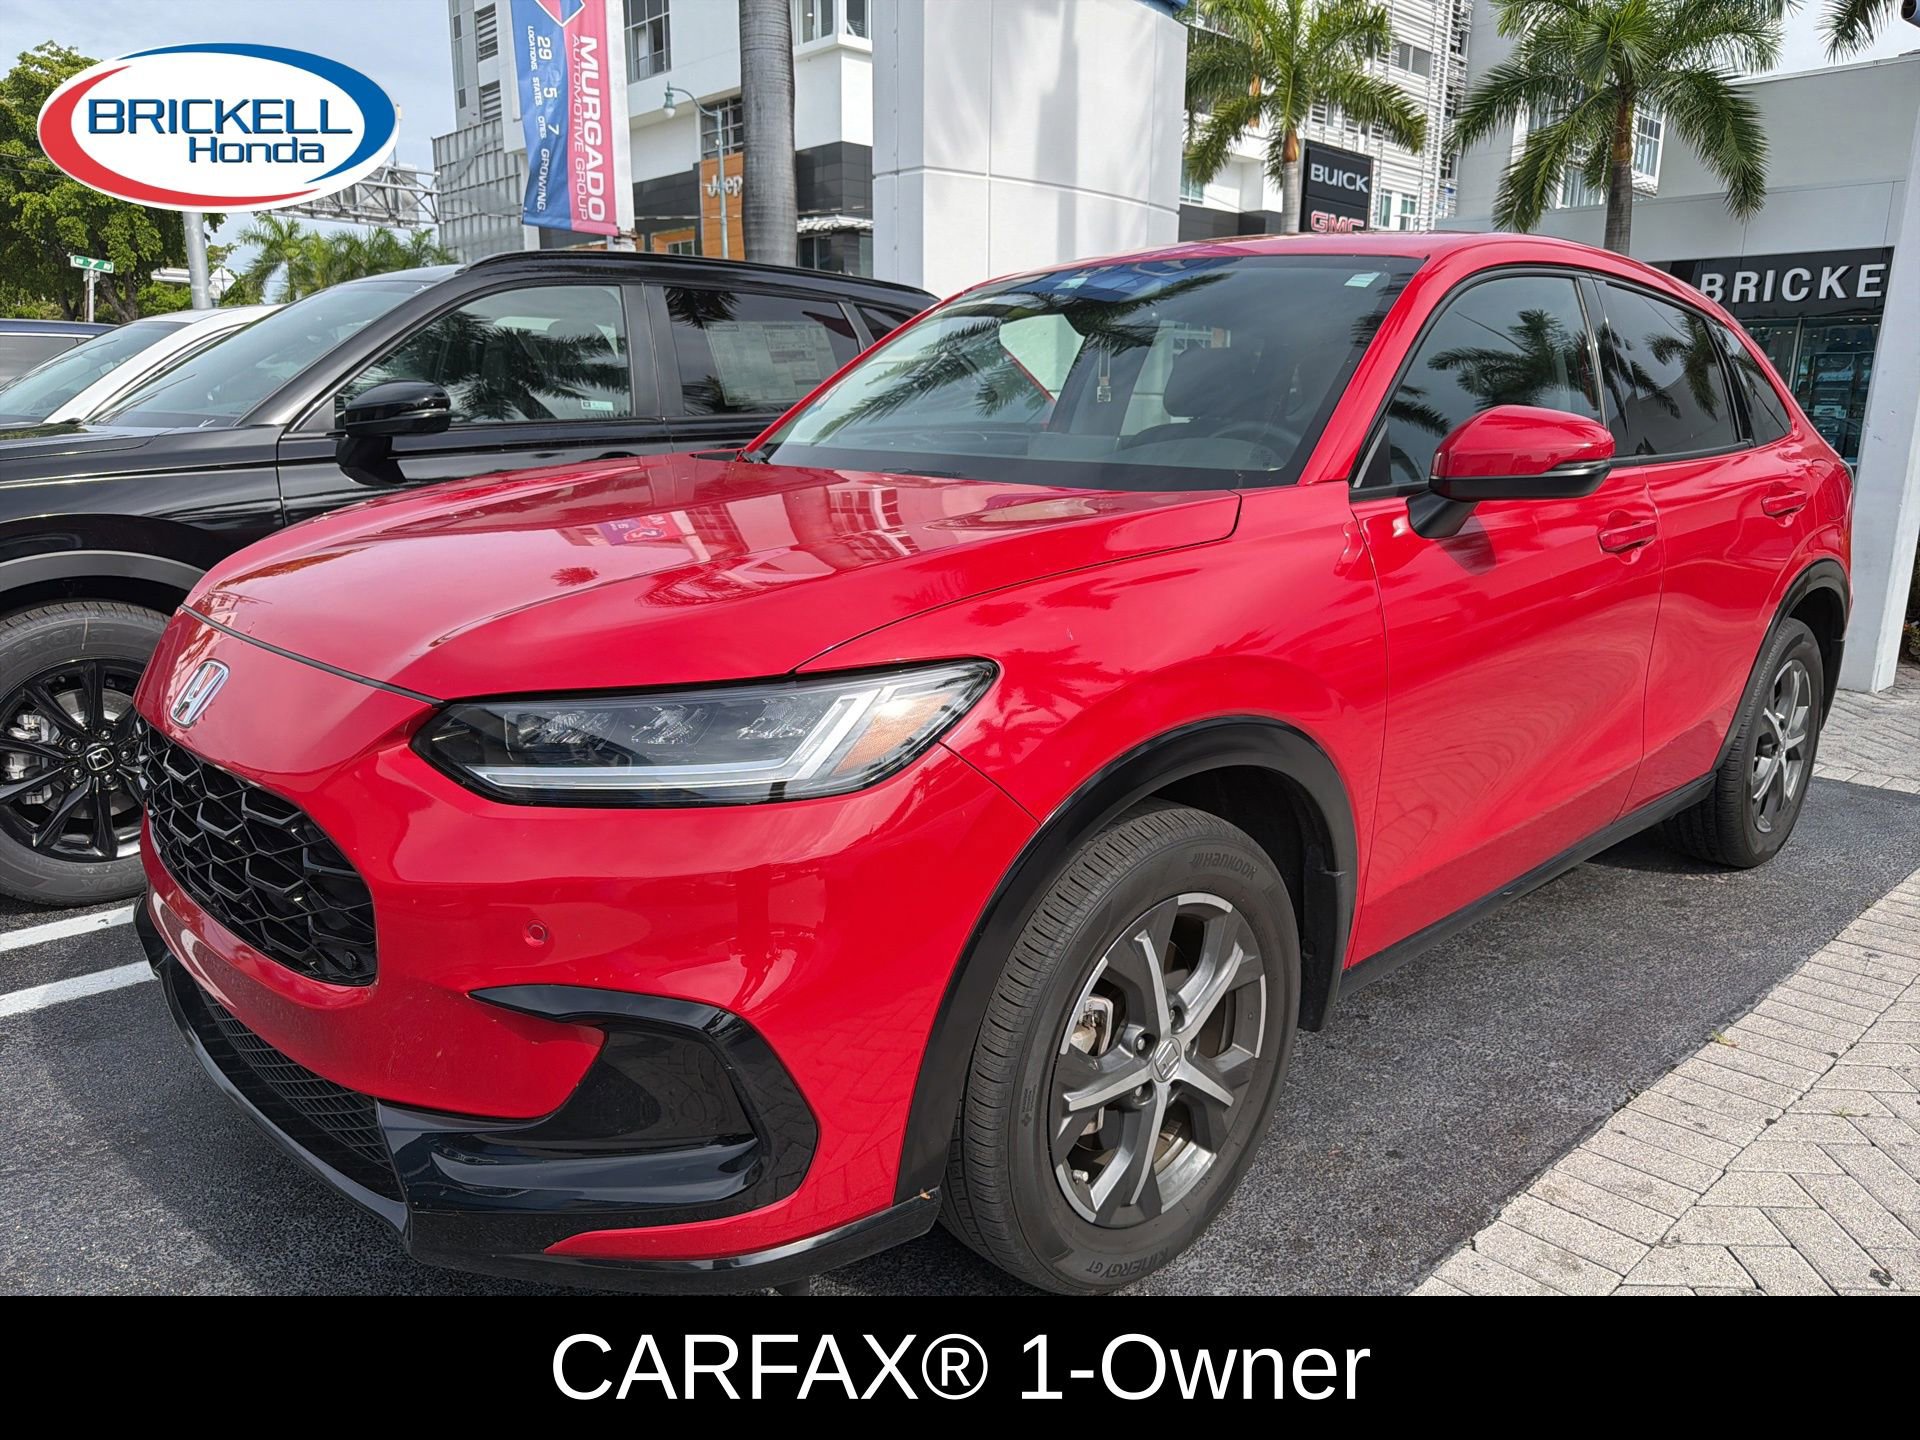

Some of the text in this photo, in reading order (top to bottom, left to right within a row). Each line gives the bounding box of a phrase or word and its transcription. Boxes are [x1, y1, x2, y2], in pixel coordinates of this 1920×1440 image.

[537, 35, 560, 136] 29 5 7
[572, 33, 588, 220] AUTOMOTIVE GROUP
[580, 35, 605, 221] MURGADO
[537, 148, 550, 213] GROWING.
[1311, 163, 1369, 193] BUICK
[1311, 210, 1364, 233] GMC
[1700, 264, 1886, 303] BRICKE
